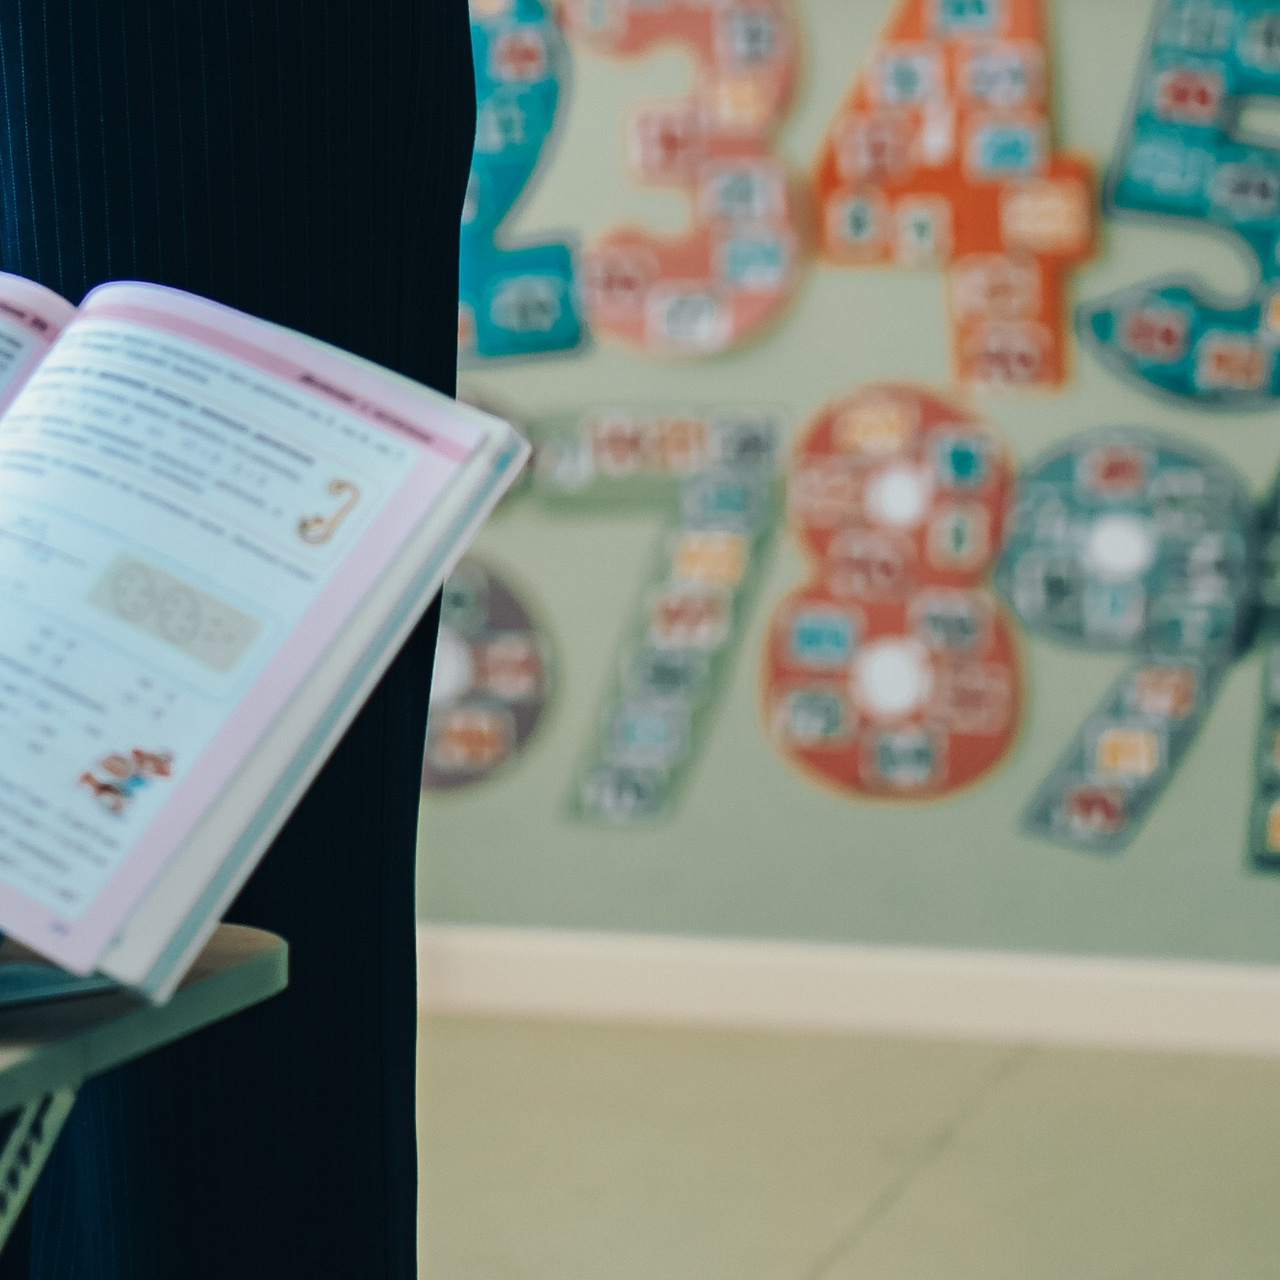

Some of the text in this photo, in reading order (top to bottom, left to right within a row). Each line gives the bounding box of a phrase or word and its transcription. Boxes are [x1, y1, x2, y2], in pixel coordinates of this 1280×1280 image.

[526, 382, 1260, 853] 7 8 9
